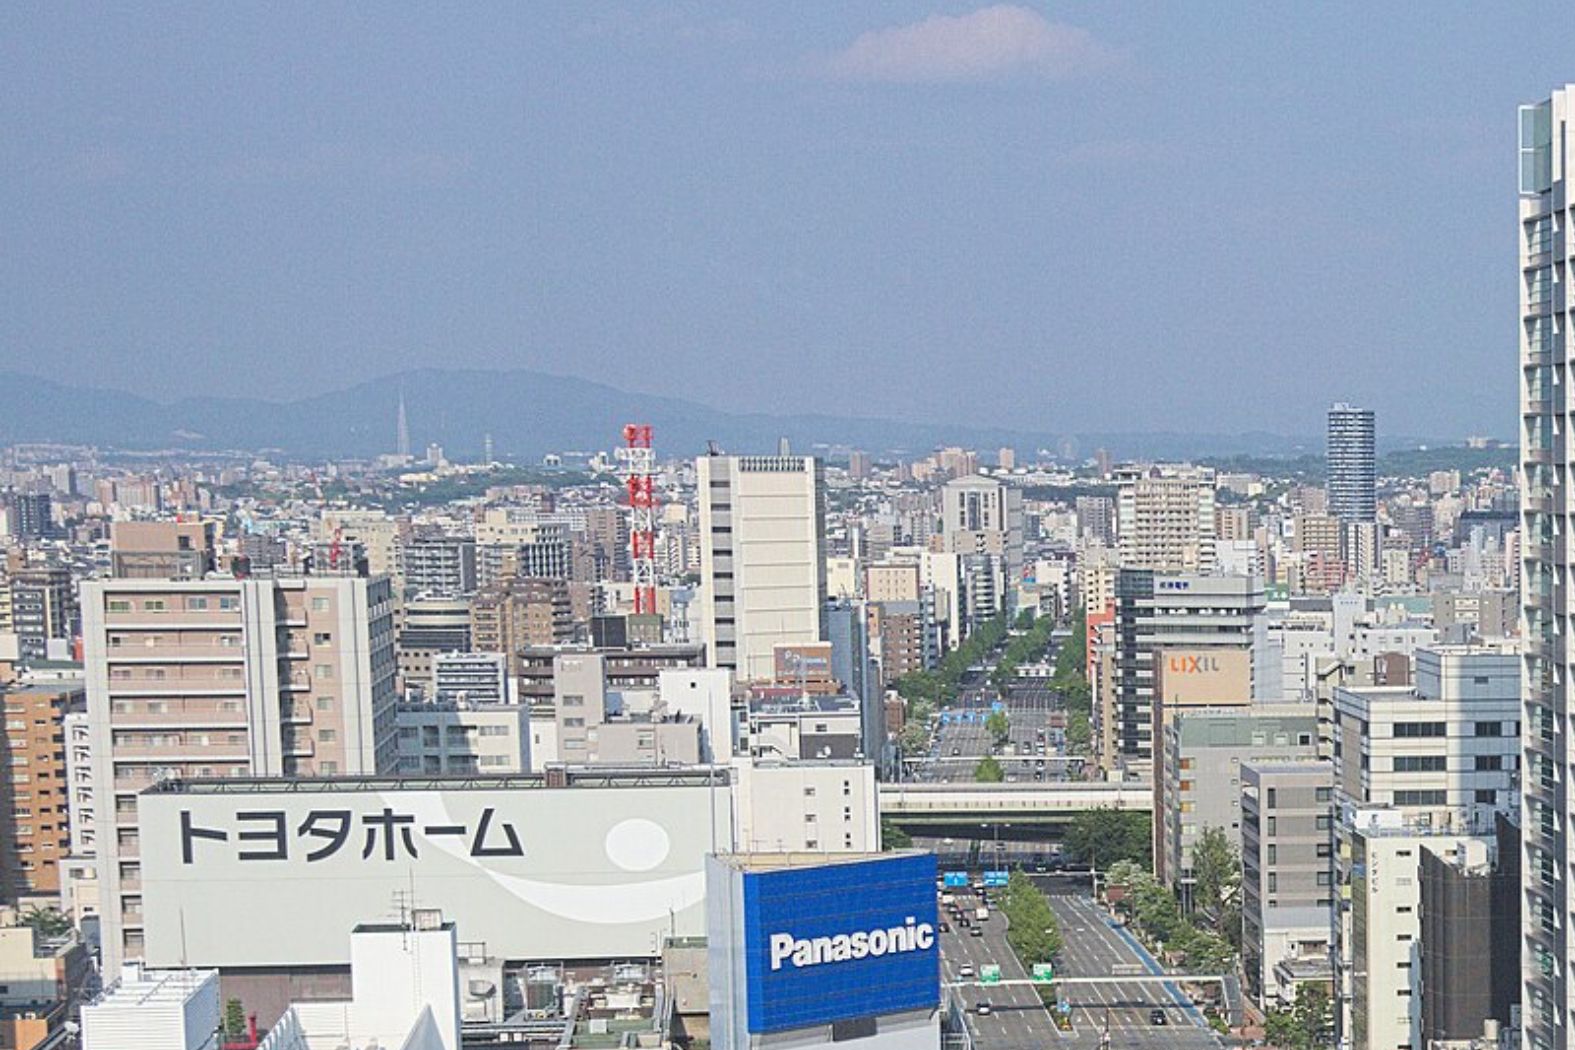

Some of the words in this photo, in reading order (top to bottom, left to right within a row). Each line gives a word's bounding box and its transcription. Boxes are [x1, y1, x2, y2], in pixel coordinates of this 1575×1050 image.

[1170, 655, 1220, 674] LIXIL
[180, 808, 525, 864] トヨタホーム
[770, 916, 934, 971] Panasonic
